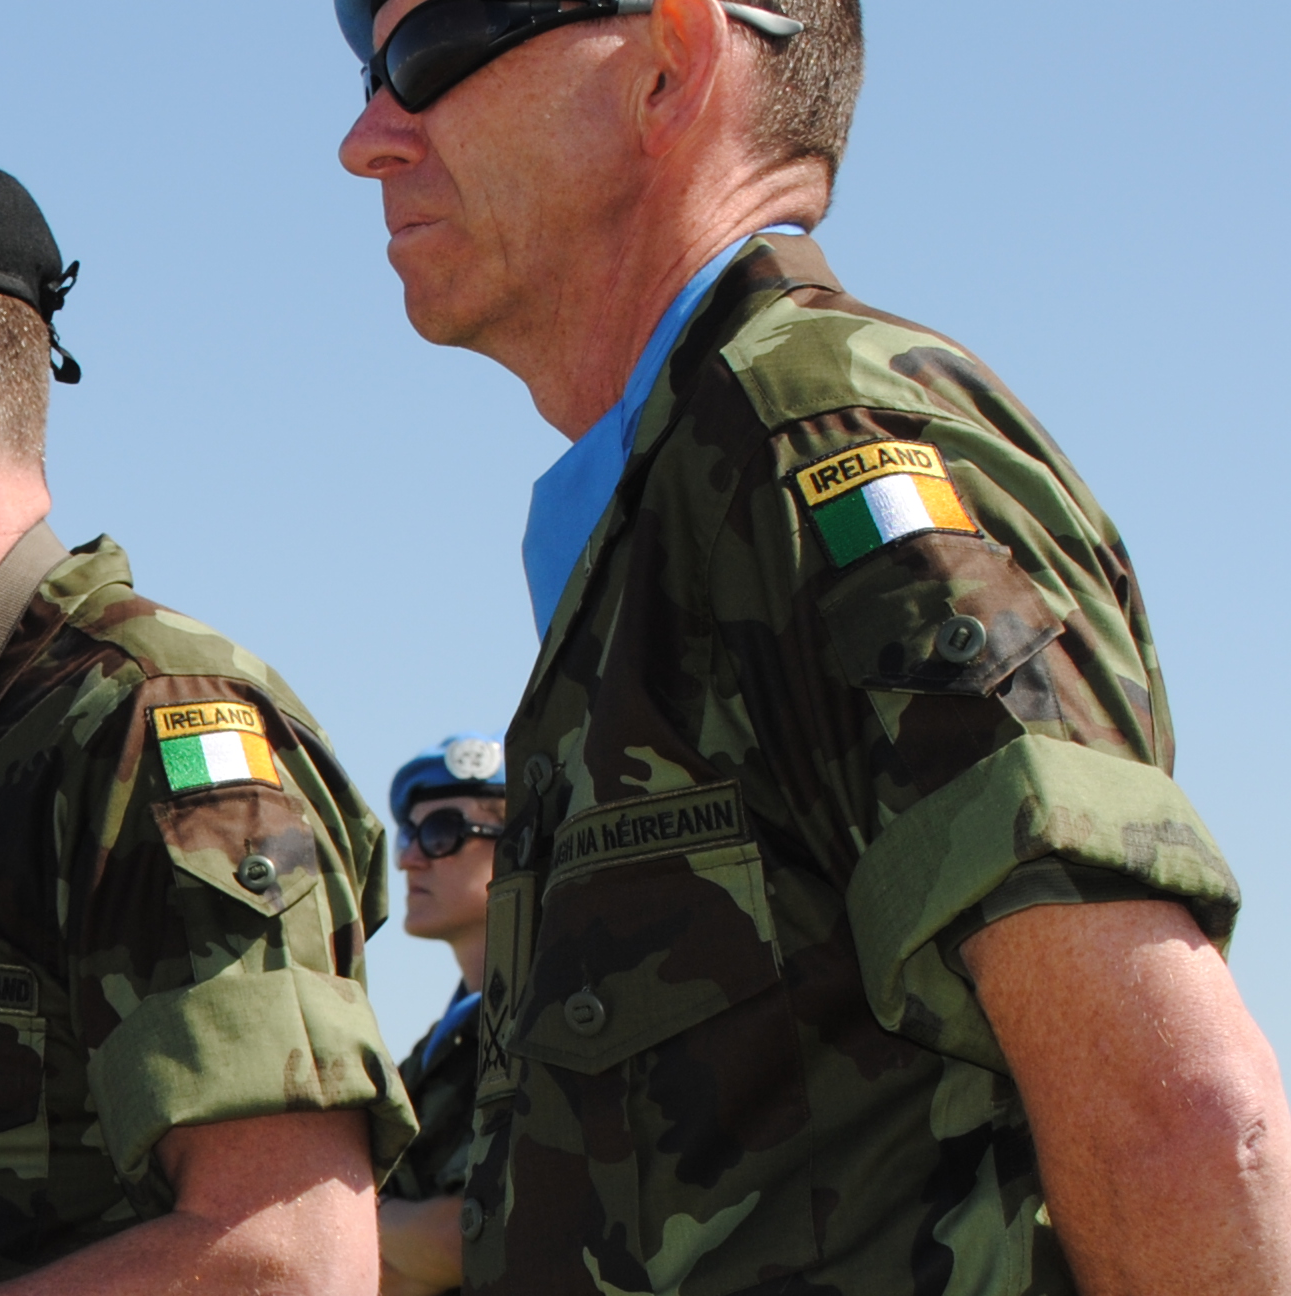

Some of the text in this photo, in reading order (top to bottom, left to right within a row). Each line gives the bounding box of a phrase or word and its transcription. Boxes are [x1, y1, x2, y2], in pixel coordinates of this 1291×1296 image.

[809, 448, 932, 494] IRELAND
[163, 707, 255, 731] IRELAND
[577, 826, 597, 859] NA
[602, 800, 734, 851] hÉIREANN
